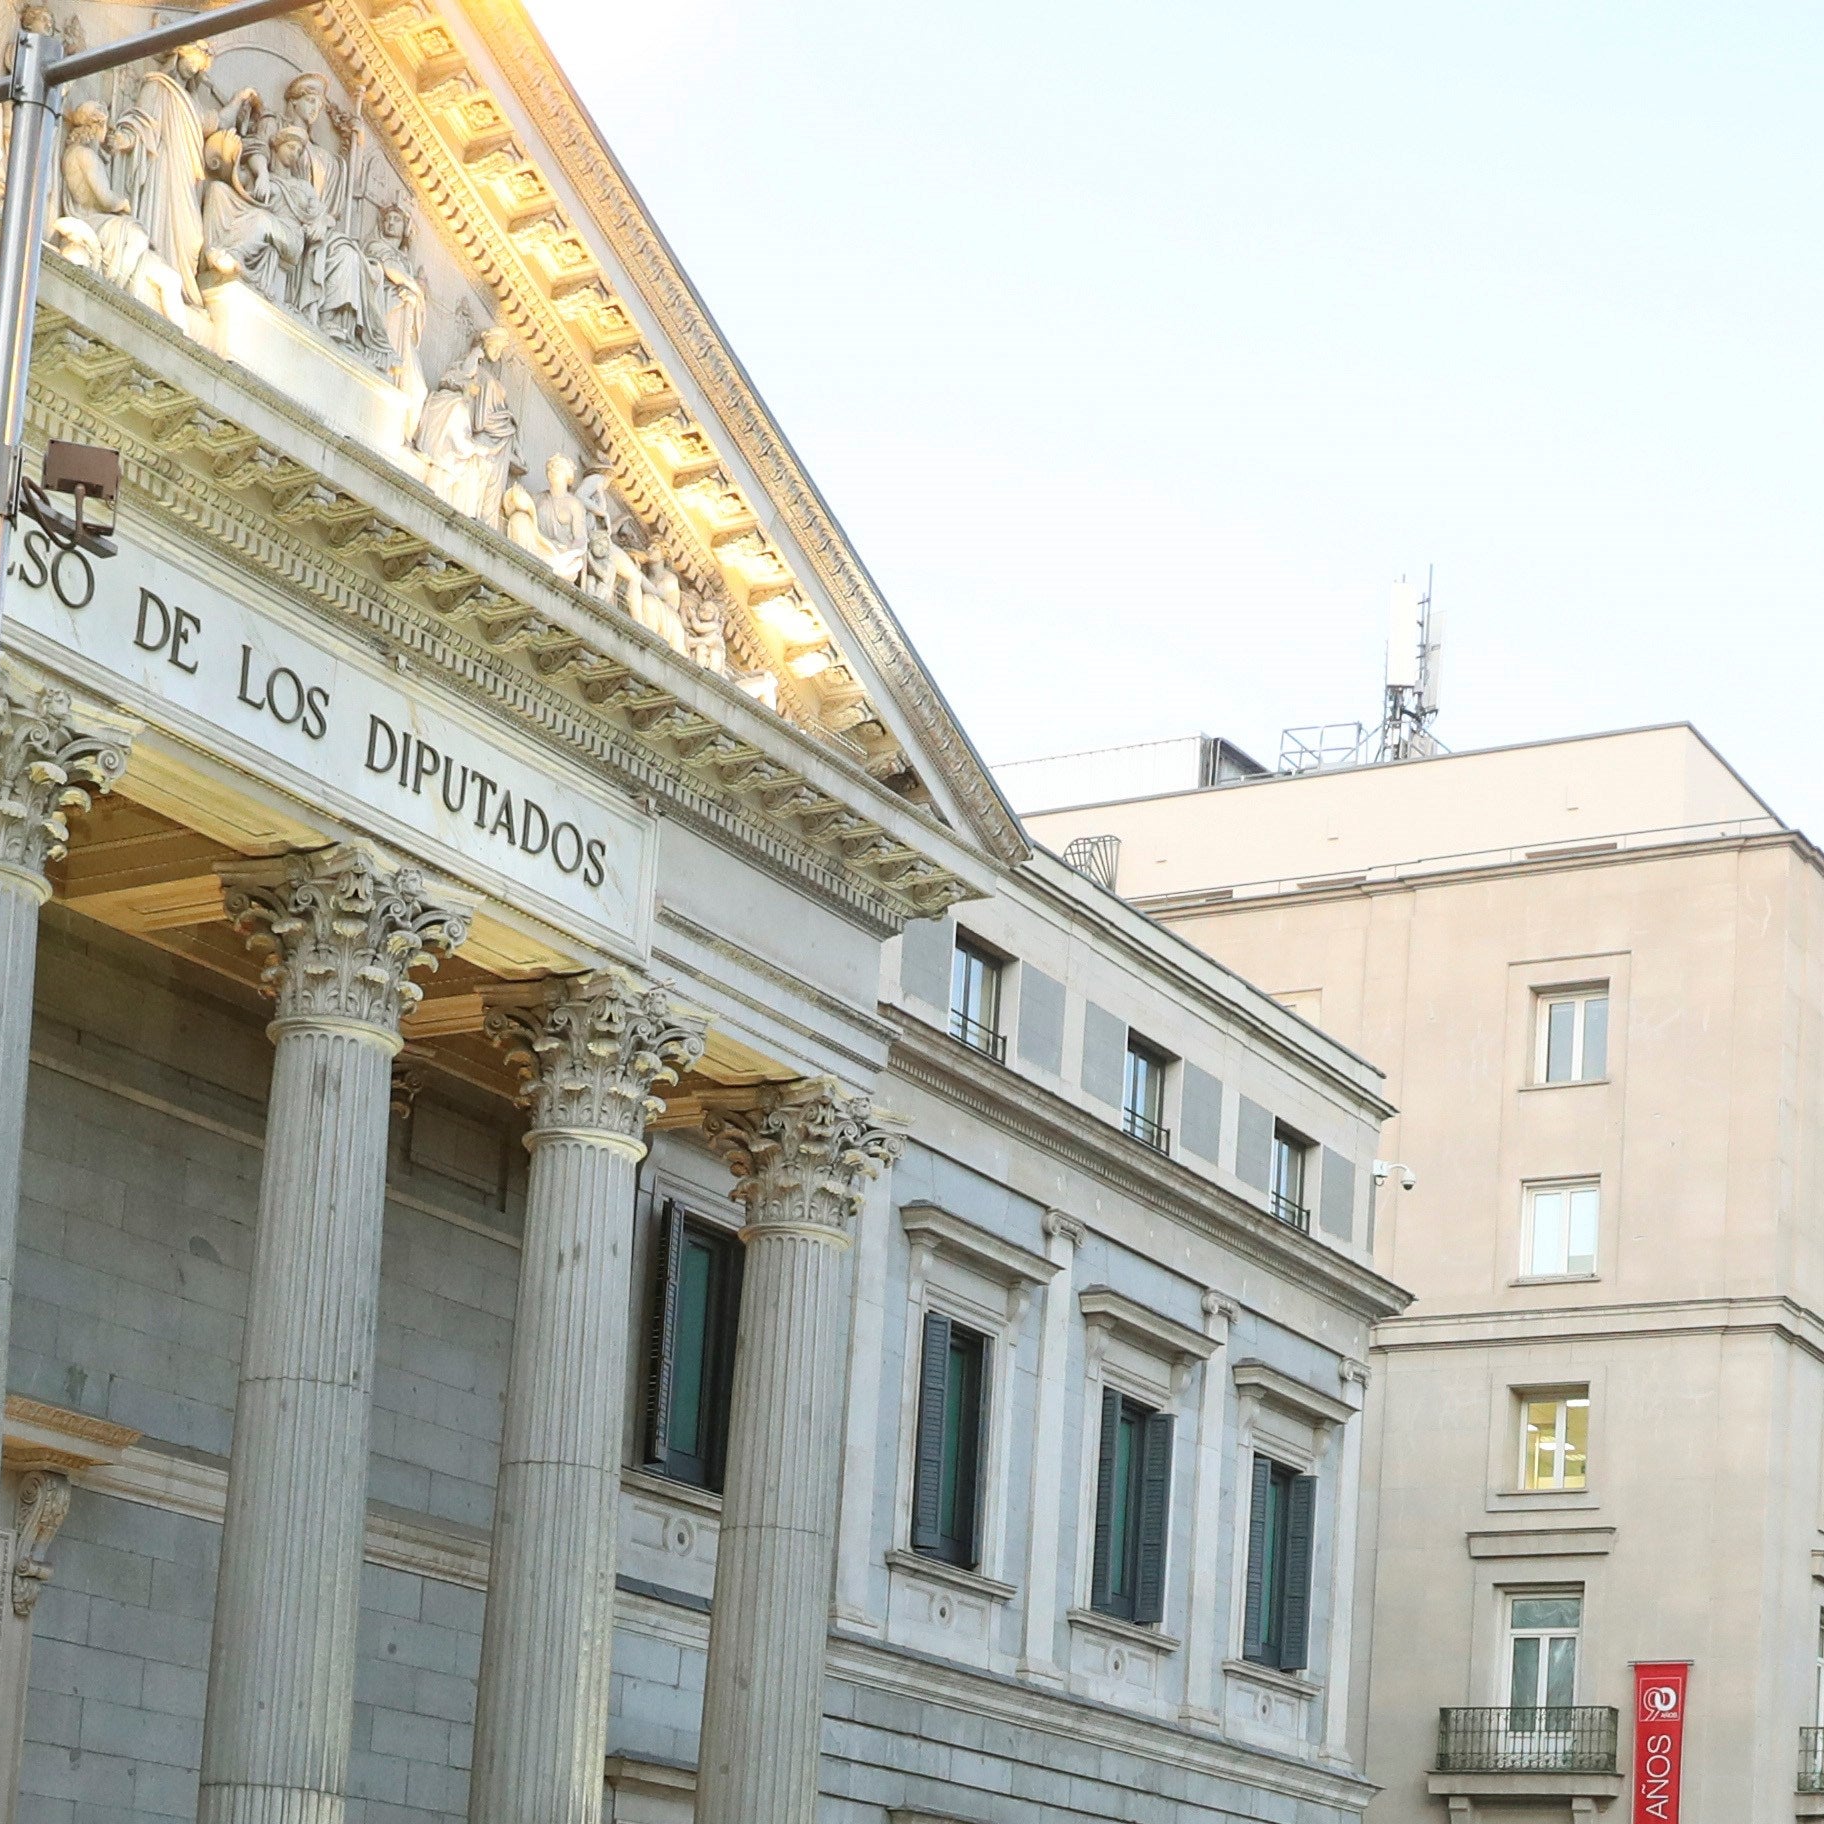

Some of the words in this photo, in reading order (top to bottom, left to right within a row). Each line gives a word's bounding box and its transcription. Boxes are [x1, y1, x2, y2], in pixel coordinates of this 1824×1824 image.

[134, 587, 201, 674] DE
[237, 644, 329, 740] LOS
[364, 713, 607, 887] DIPUTADOS
[1641, 1734, 1672, 1820] AÑOS
